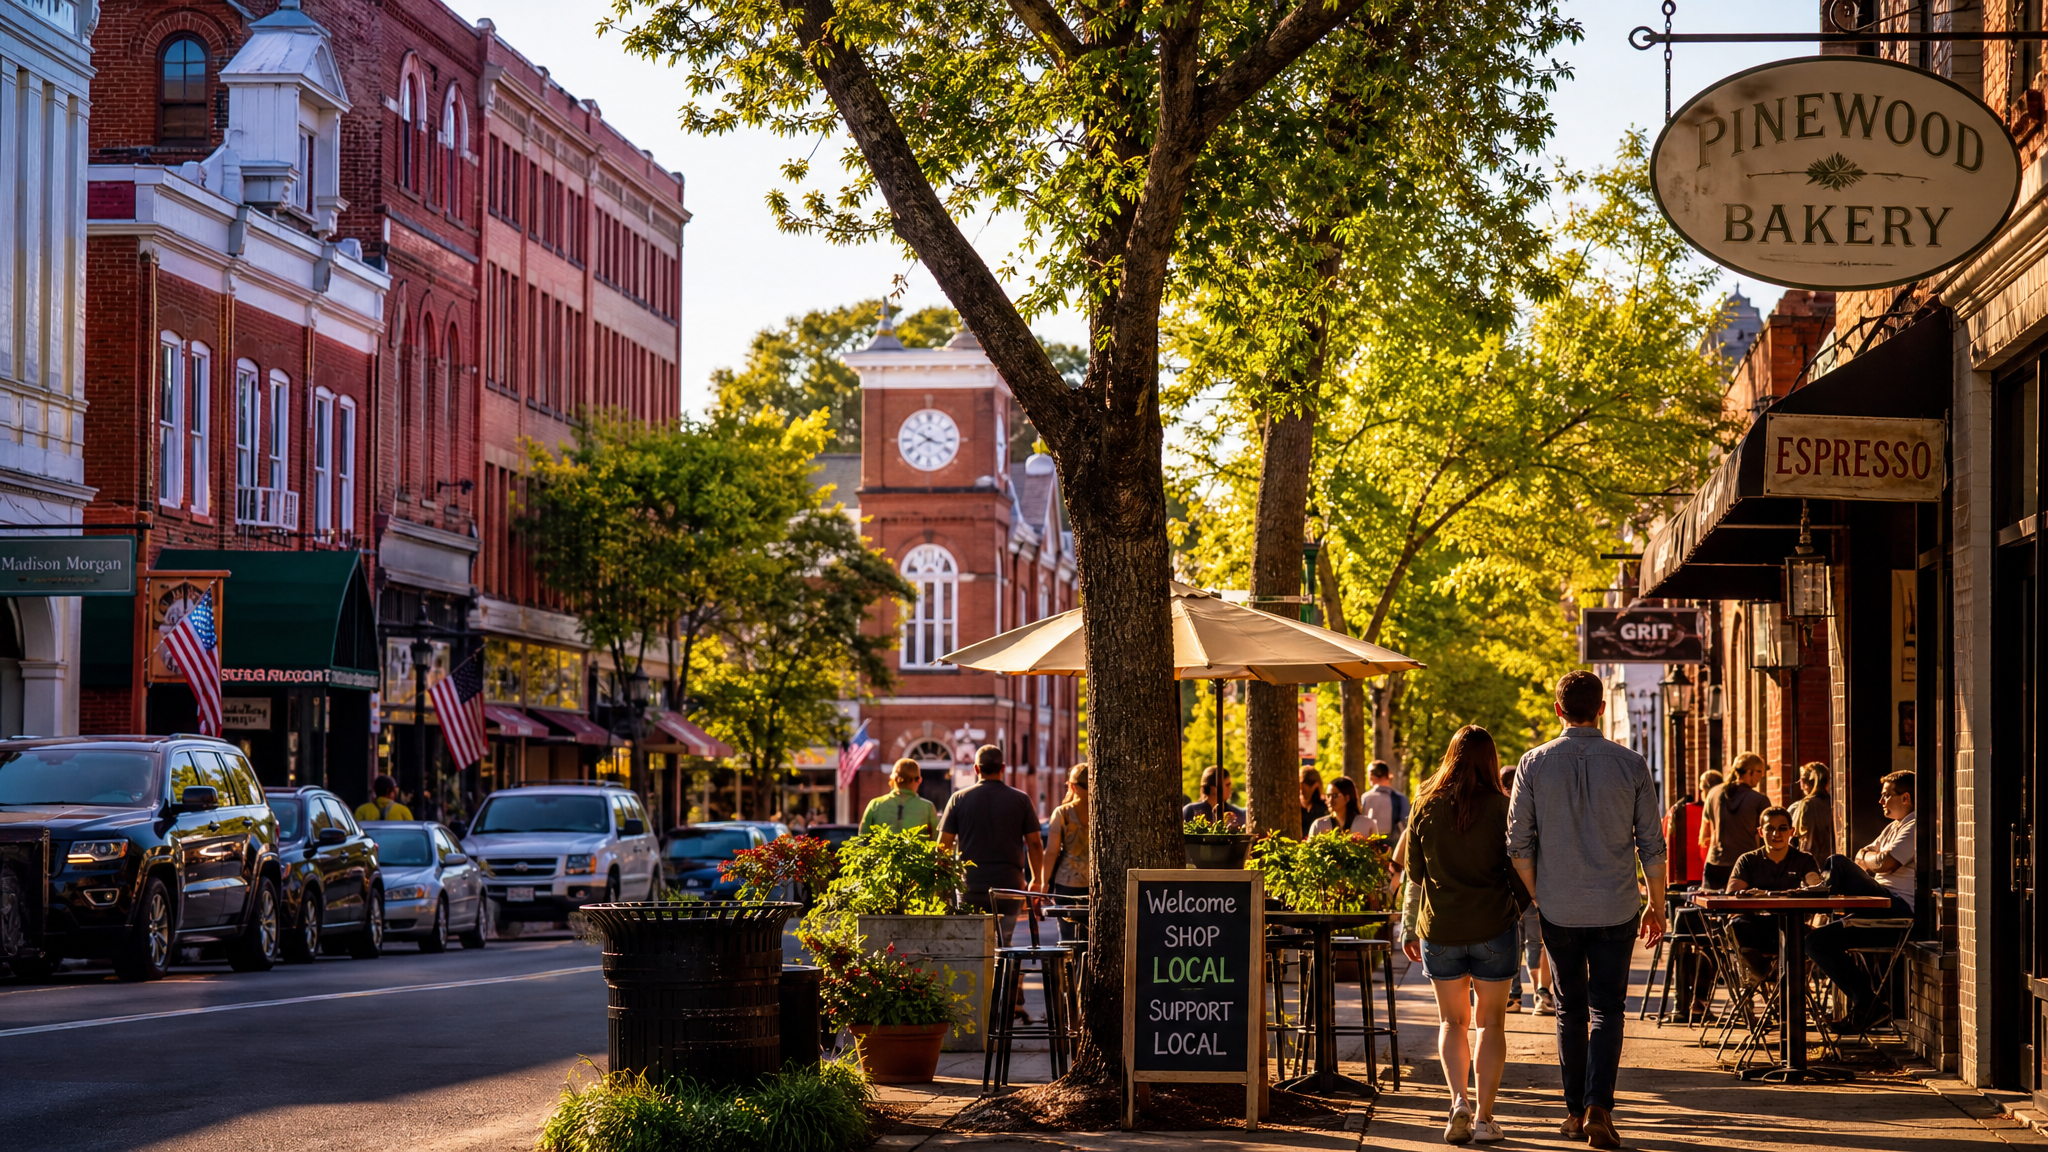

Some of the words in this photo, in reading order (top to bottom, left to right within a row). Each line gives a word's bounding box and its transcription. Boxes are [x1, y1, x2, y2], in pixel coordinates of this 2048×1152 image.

[1696, 91, 1984, 174] PINEWOOD
[1722, 203, 1954, 248] BAKERY
[1775, 436, 1932, 481] ESPRESSO
[1, 555, 61, 571] Madison
[66, 555, 122, 574] Morgan
[1620, 622, 1674, 641] GRIT
[1145, 888, 1237, 914] Welcome
[1164, 924, 1221, 948] SHOP
[1152, 956, 1235, 984] LOCAL
[1149, 999, 1234, 1022] SUPPORT
[1154, 1031, 1228, 1056] LOCAL
